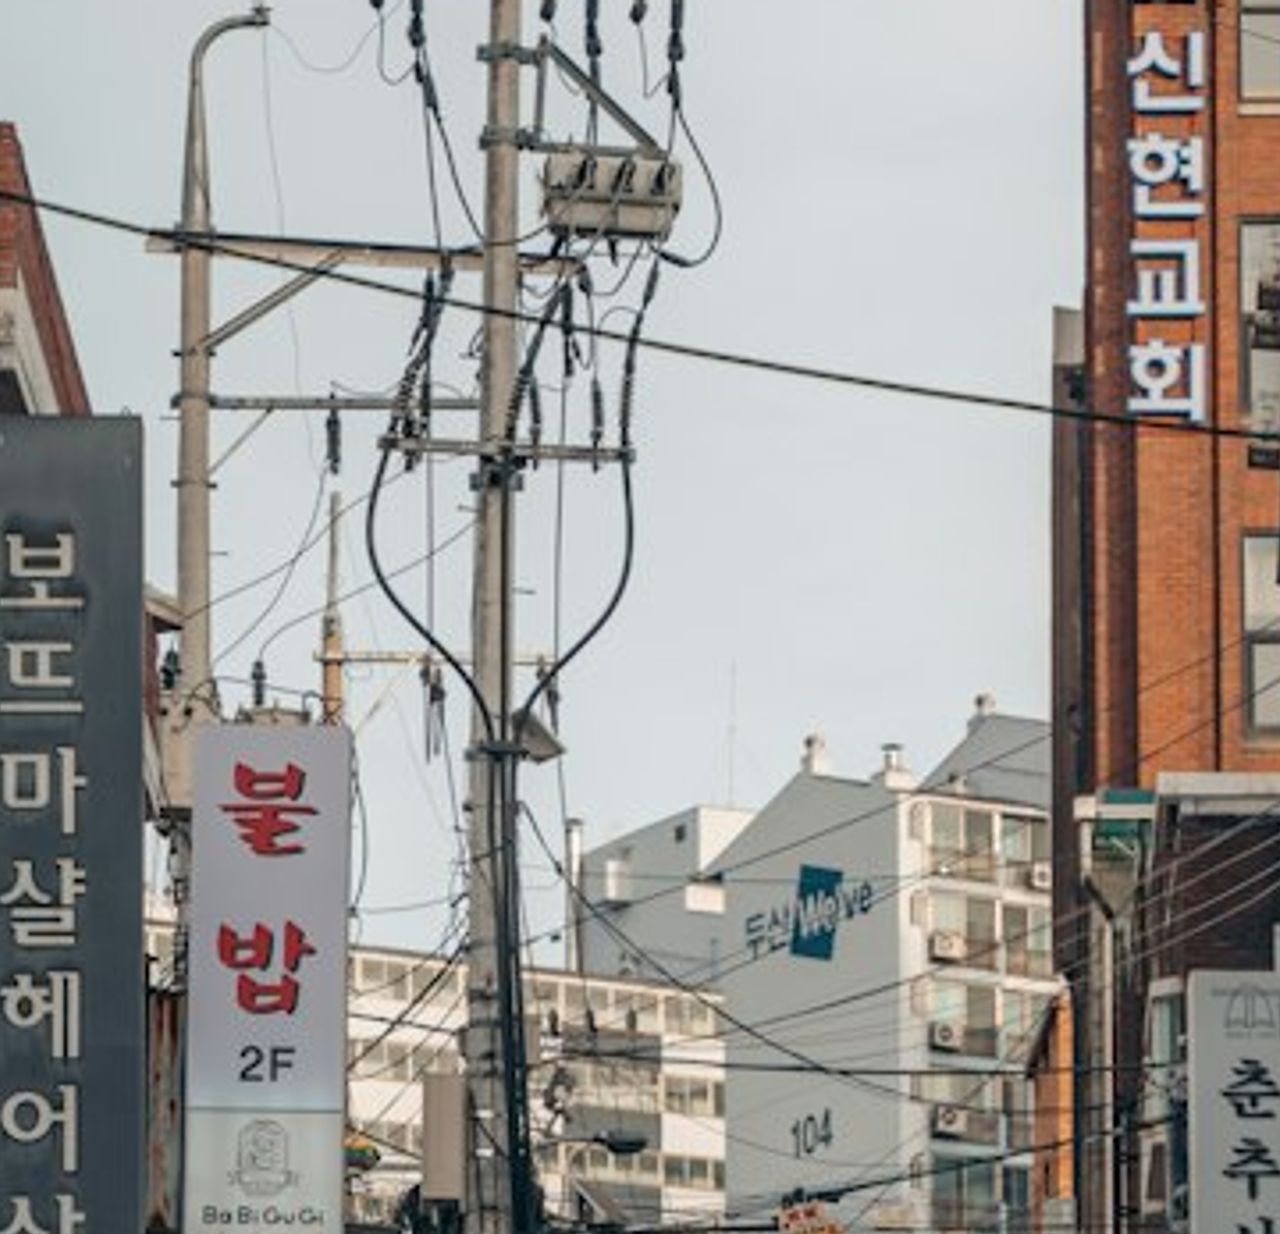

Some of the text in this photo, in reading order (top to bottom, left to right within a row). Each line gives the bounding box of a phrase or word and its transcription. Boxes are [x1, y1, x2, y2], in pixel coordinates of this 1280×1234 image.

[1126, 31, 1206, 423] 신현교회
[238, 1046, 296, 1082] 2F
[791, 1109, 834, 1160] 104
